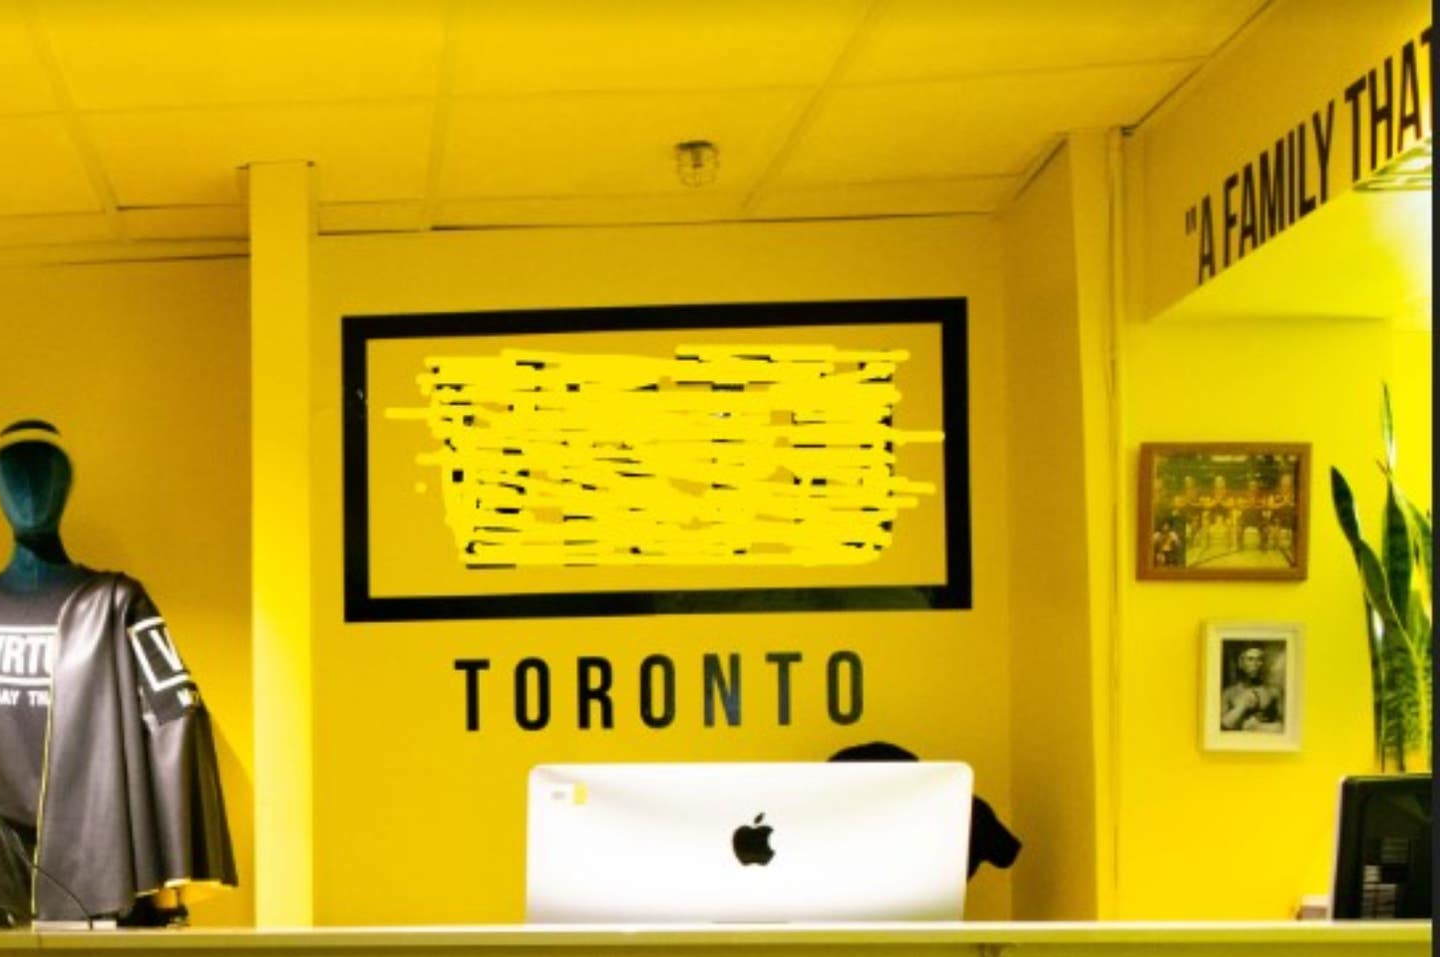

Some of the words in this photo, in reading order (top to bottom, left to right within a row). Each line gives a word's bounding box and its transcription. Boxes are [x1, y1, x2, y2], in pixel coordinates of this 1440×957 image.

[1224, 99, 1335, 269] FAMILY
[26, 690, 50, 706] TH
[453, 650, 865, 732] TORONTO
